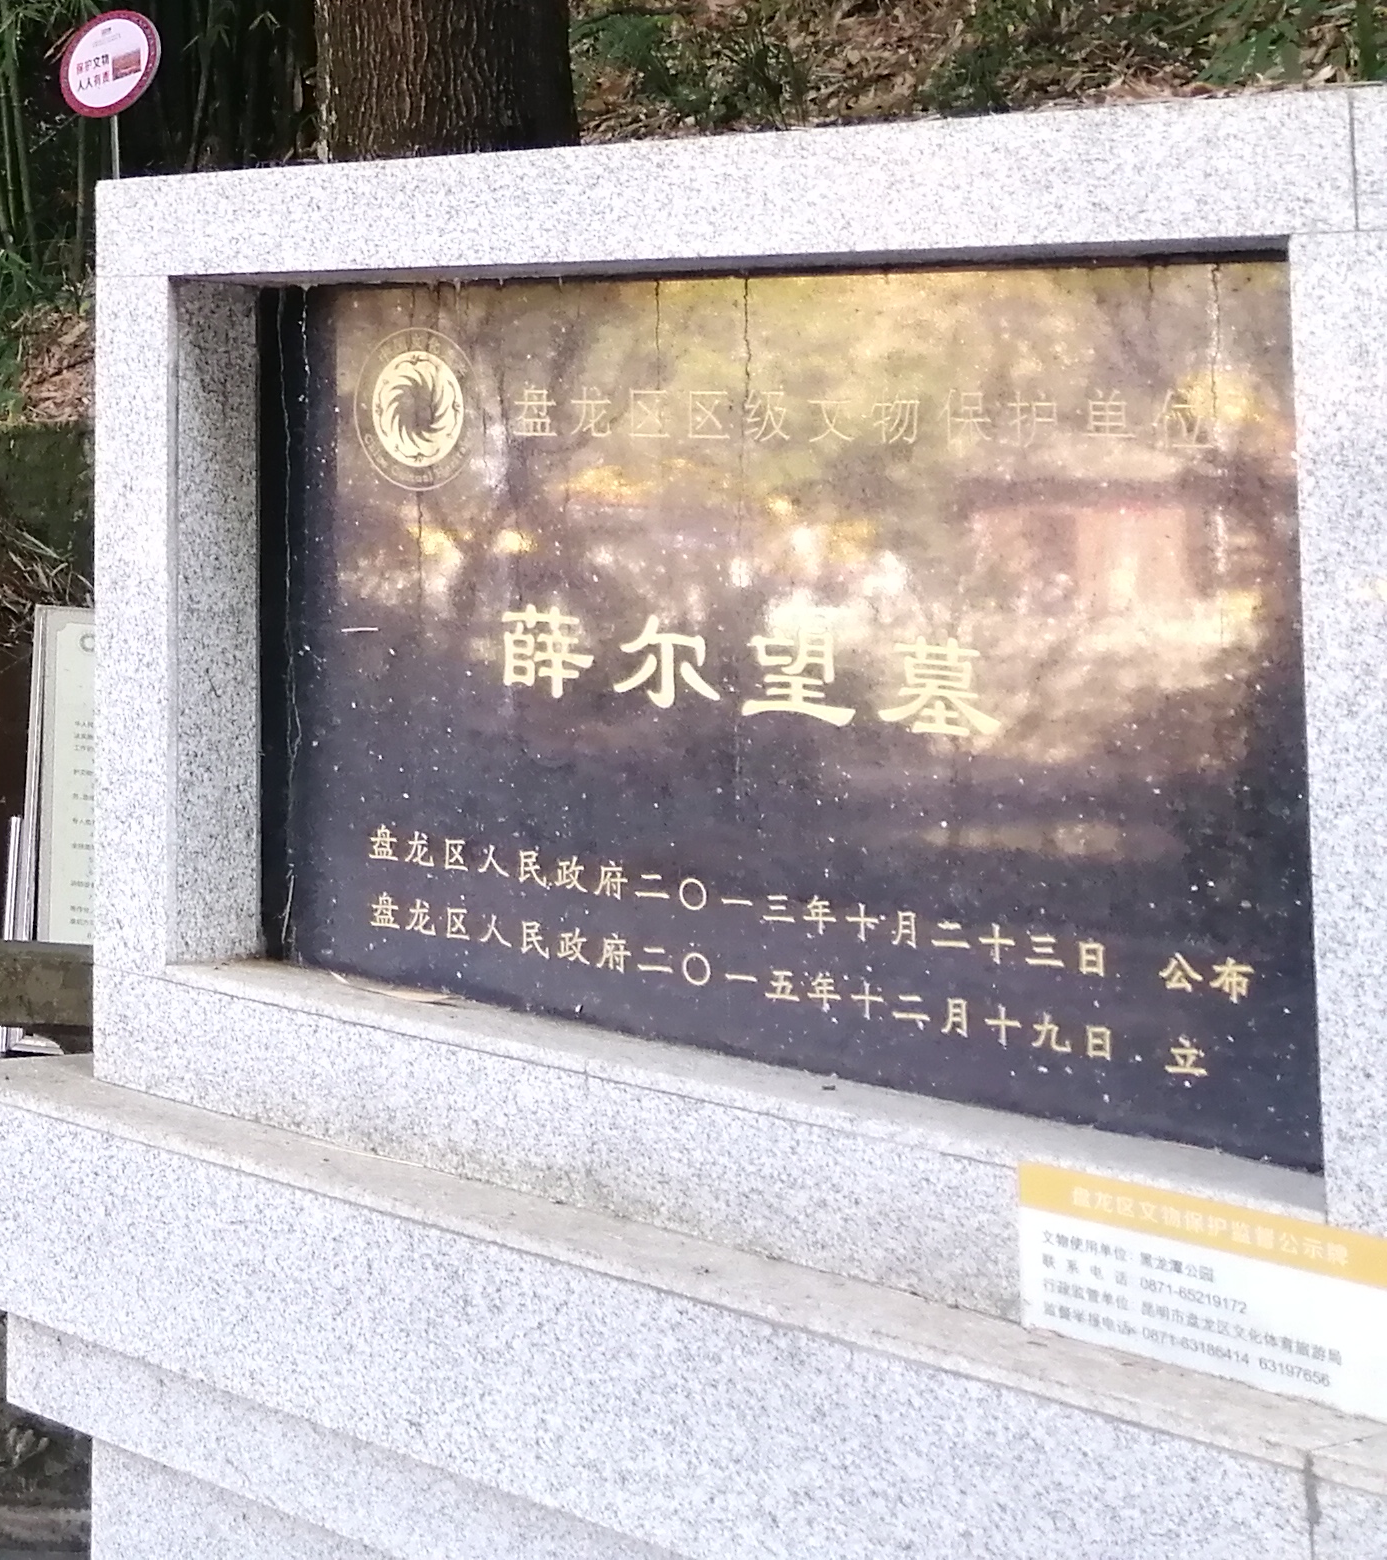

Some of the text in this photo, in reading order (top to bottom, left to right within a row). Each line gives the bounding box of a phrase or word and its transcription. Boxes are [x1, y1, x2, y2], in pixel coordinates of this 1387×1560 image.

[512, 383, 1218, 449] 盘龙区区级文物保护单位
[500, 603, 1002, 738] 薛尔望墓
[1160, 953, 1255, 1006] 公布
[1166, 1040, 1210, 1078] 立
[1072, 1186, 1349, 1267] 盘龙区文物保护监督公示牌
[1140, 1276, 1247, 1315] 0871-65219172
